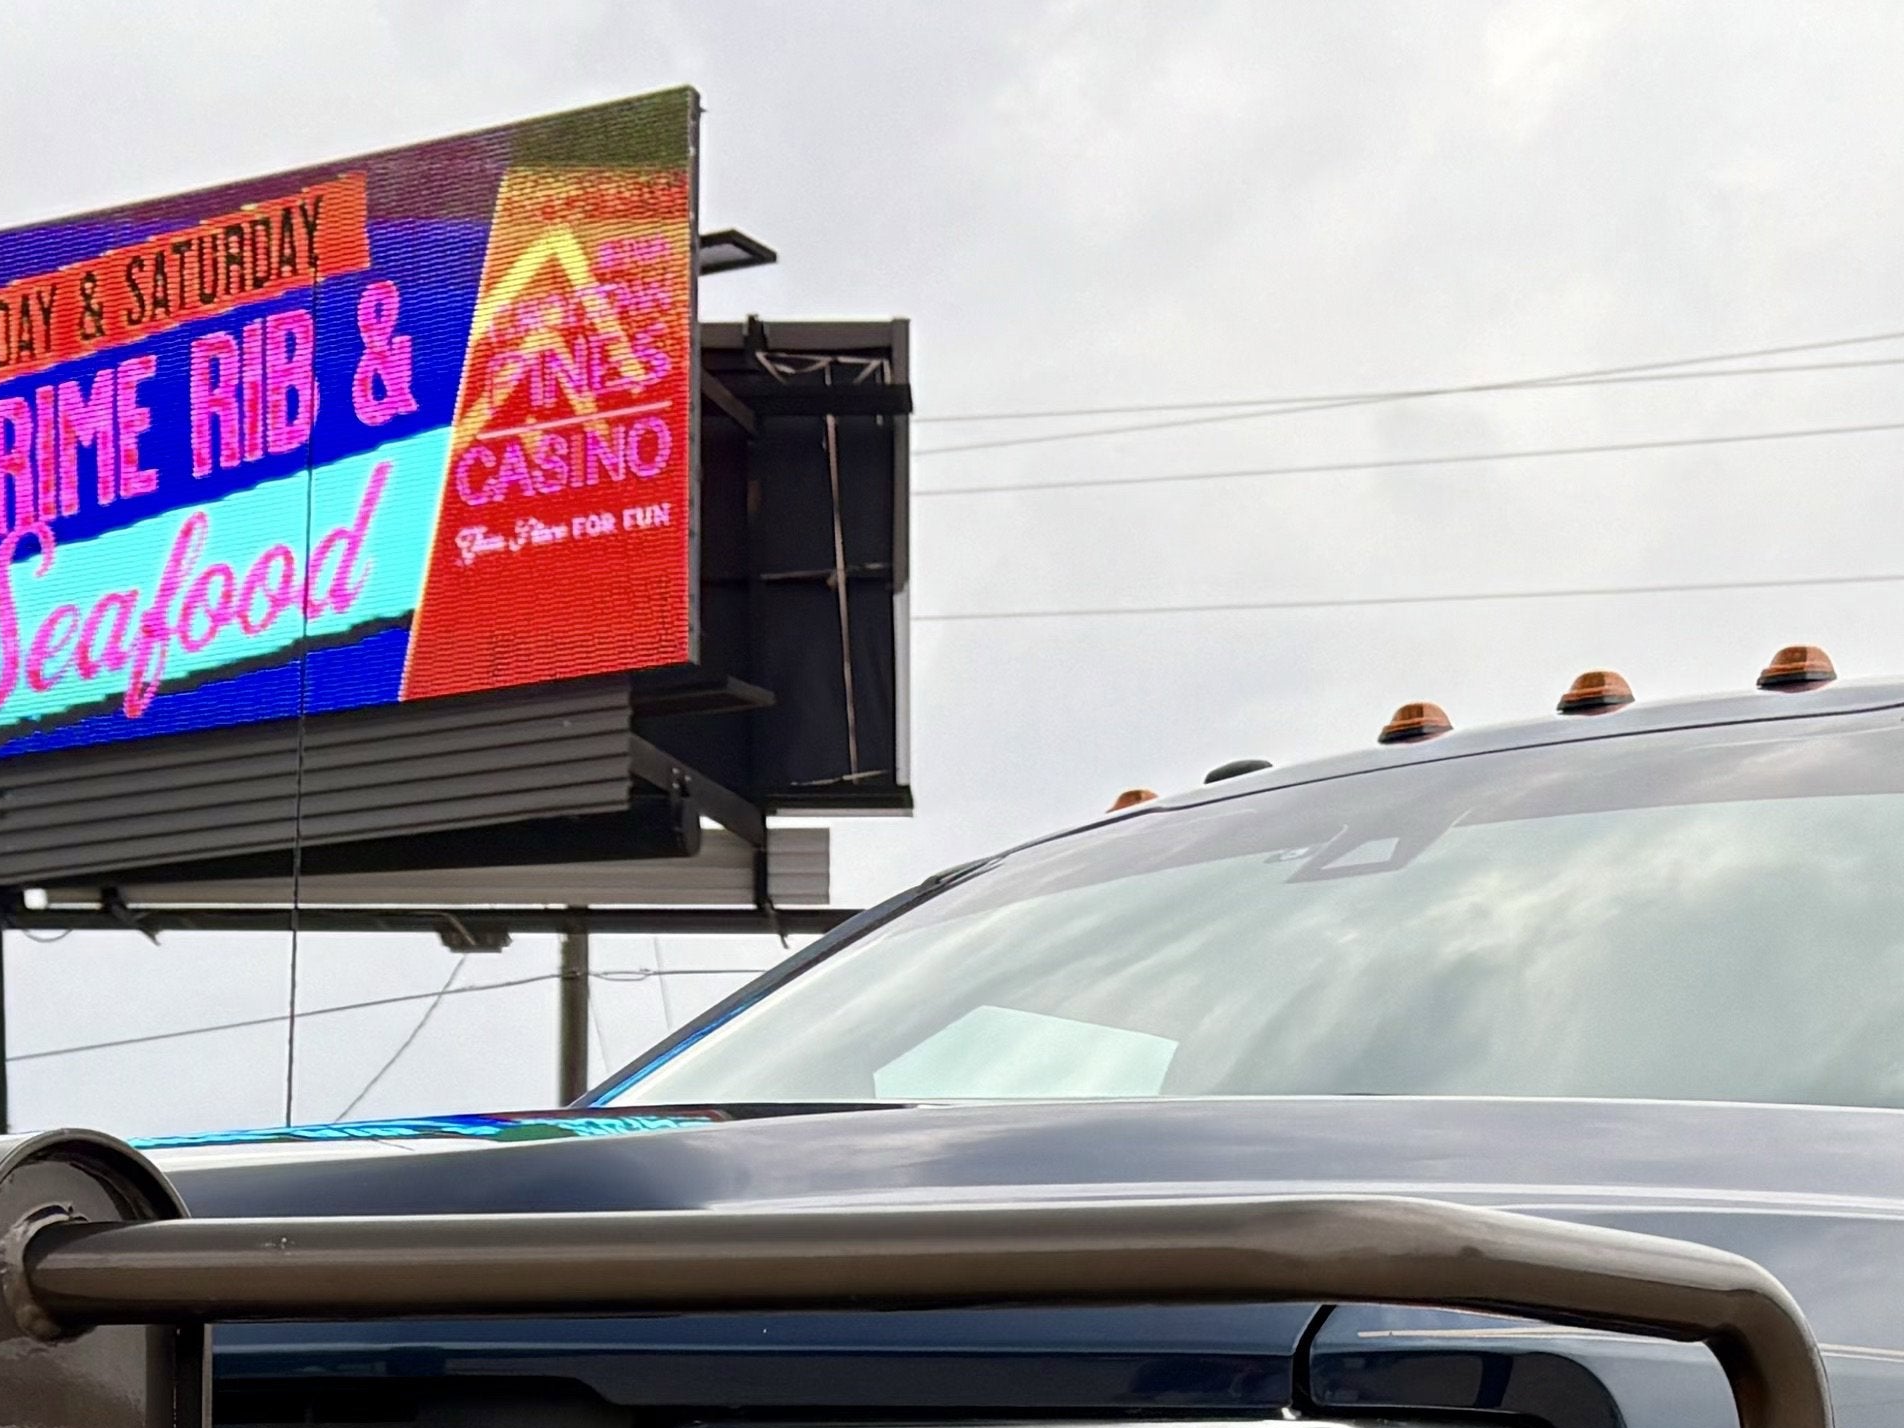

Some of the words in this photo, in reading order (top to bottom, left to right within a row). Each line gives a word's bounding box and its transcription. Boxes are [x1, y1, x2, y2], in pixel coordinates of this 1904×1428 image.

[79, 272, 106, 341] &
[125, 196, 324, 327] SATURDAY
[190, 309, 320, 478] RIB
[352, 281, 419, 425] &
[455, 416, 673, 506] CASINO
[571, 513, 616, 539] FOR
[622, 502, 672, 530] FUN
